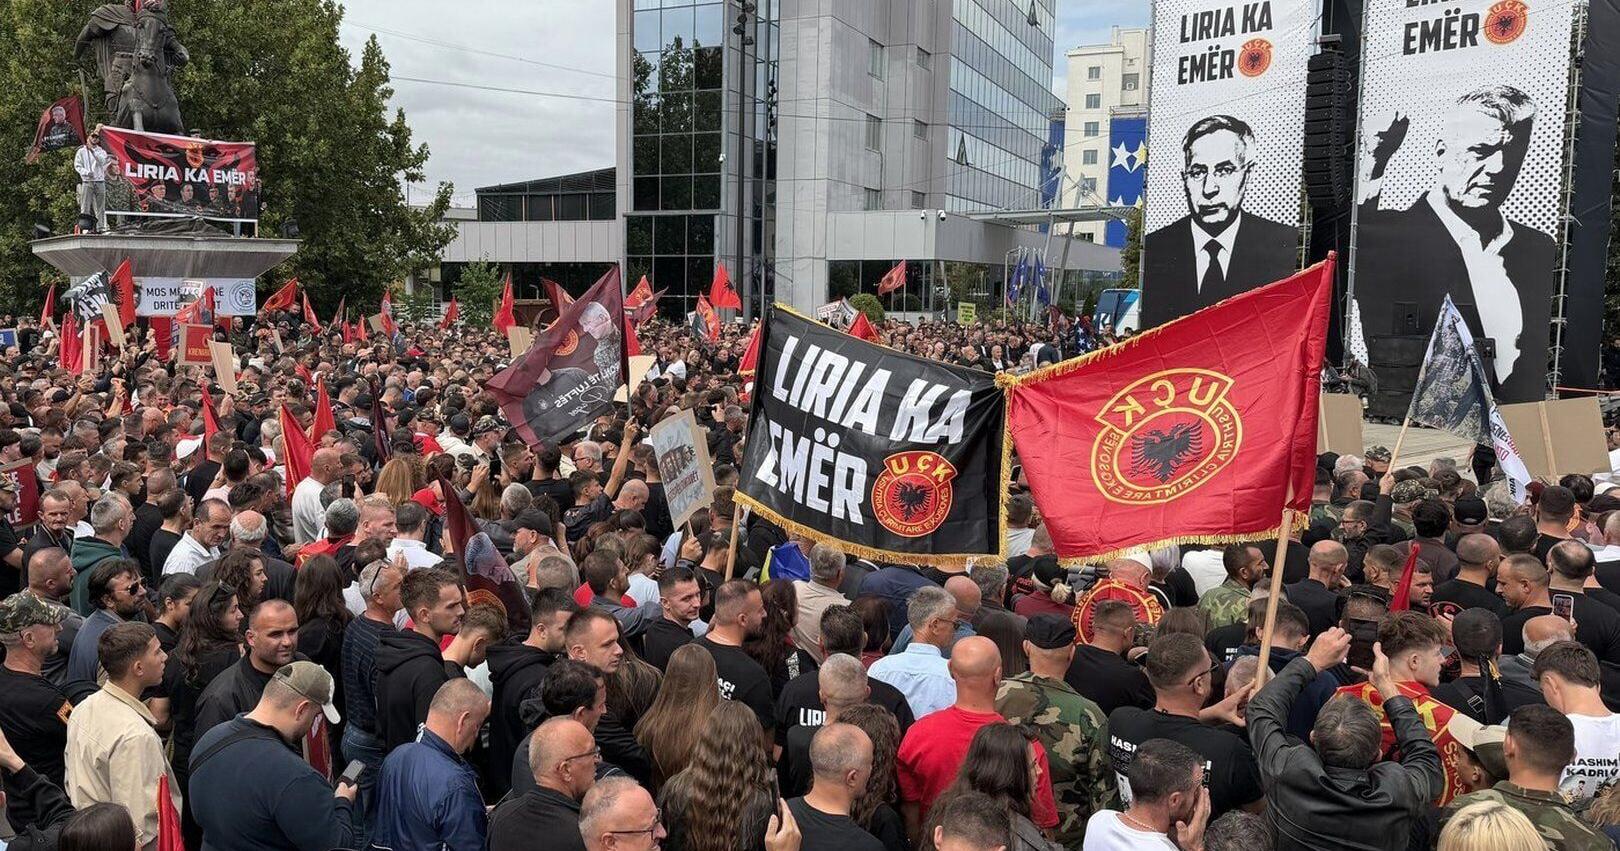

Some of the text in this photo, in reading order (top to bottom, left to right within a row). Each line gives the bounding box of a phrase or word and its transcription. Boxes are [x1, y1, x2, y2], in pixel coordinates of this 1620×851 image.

[1180, 1, 1272, 43] LIRIA KA
[1403, 7, 1480, 55] EMËR
[1178, 44, 1235, 85] EMËR
[125, 163, 246, 185] LIRIA KA EMËR
[146, 287, 167, 297] MOS
[773, 335, 973, 444] LIRIA KA
[755, 420, 867, 525] EMËR
[891, 455, 953, 482] UÇK
[1566, 768, 1608, 777] KADRI
[1572, 758, 1618, 767] ASHIM
